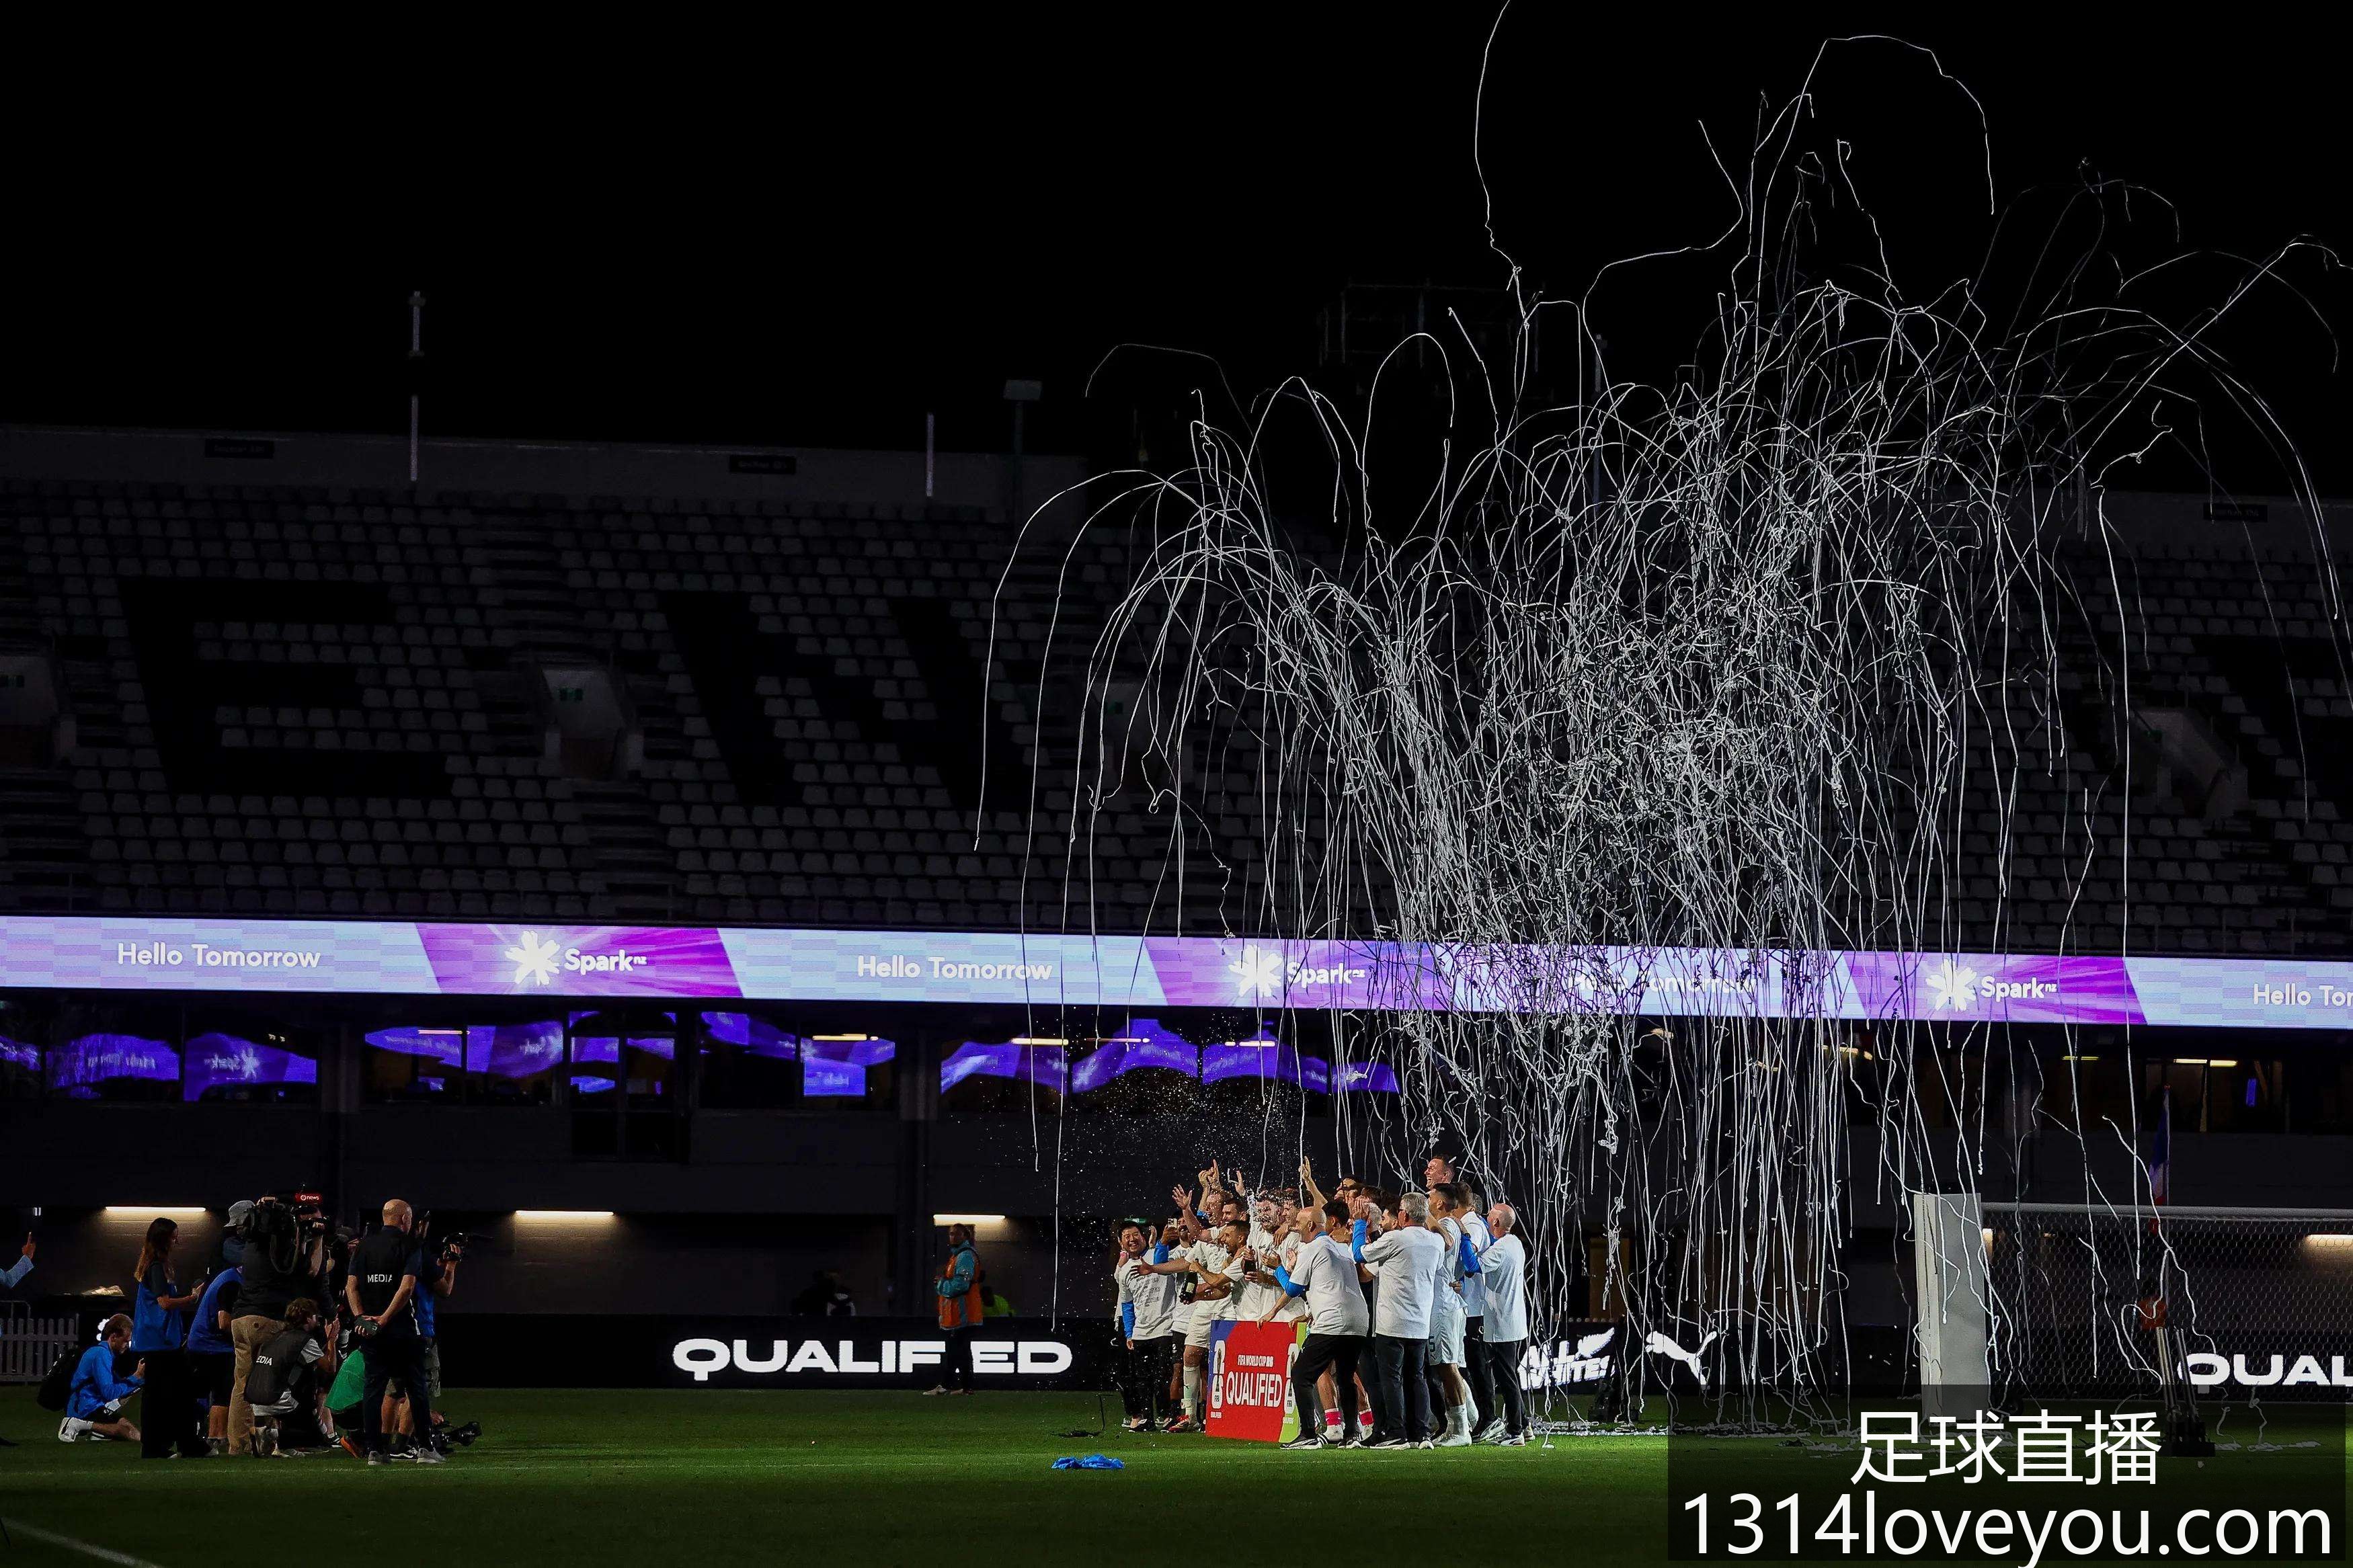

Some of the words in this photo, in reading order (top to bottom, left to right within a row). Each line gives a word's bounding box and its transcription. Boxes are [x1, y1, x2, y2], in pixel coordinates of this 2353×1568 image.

[117, 942, 183, 965] Hello
[191, 944, 321, 968] Tomorrow
[563, 948, 633, 975] Spark
[857, 954, 920, 977] Hello
[928, 956, 1052, 981] Tomorrow
[1287, 961, 1352, 989] Spark
[1981, 975, 2044, 1002] Spark
[2254, 983, 2311, 1005] Hello
[367, 1274, 393, 1283] MEDIA
[255, 1355, 273, 1366] EDIA
[672, 1338, 1073, 1381] QUALIFED
[1226, 1371, 1283, 1408] QUALIFIED
